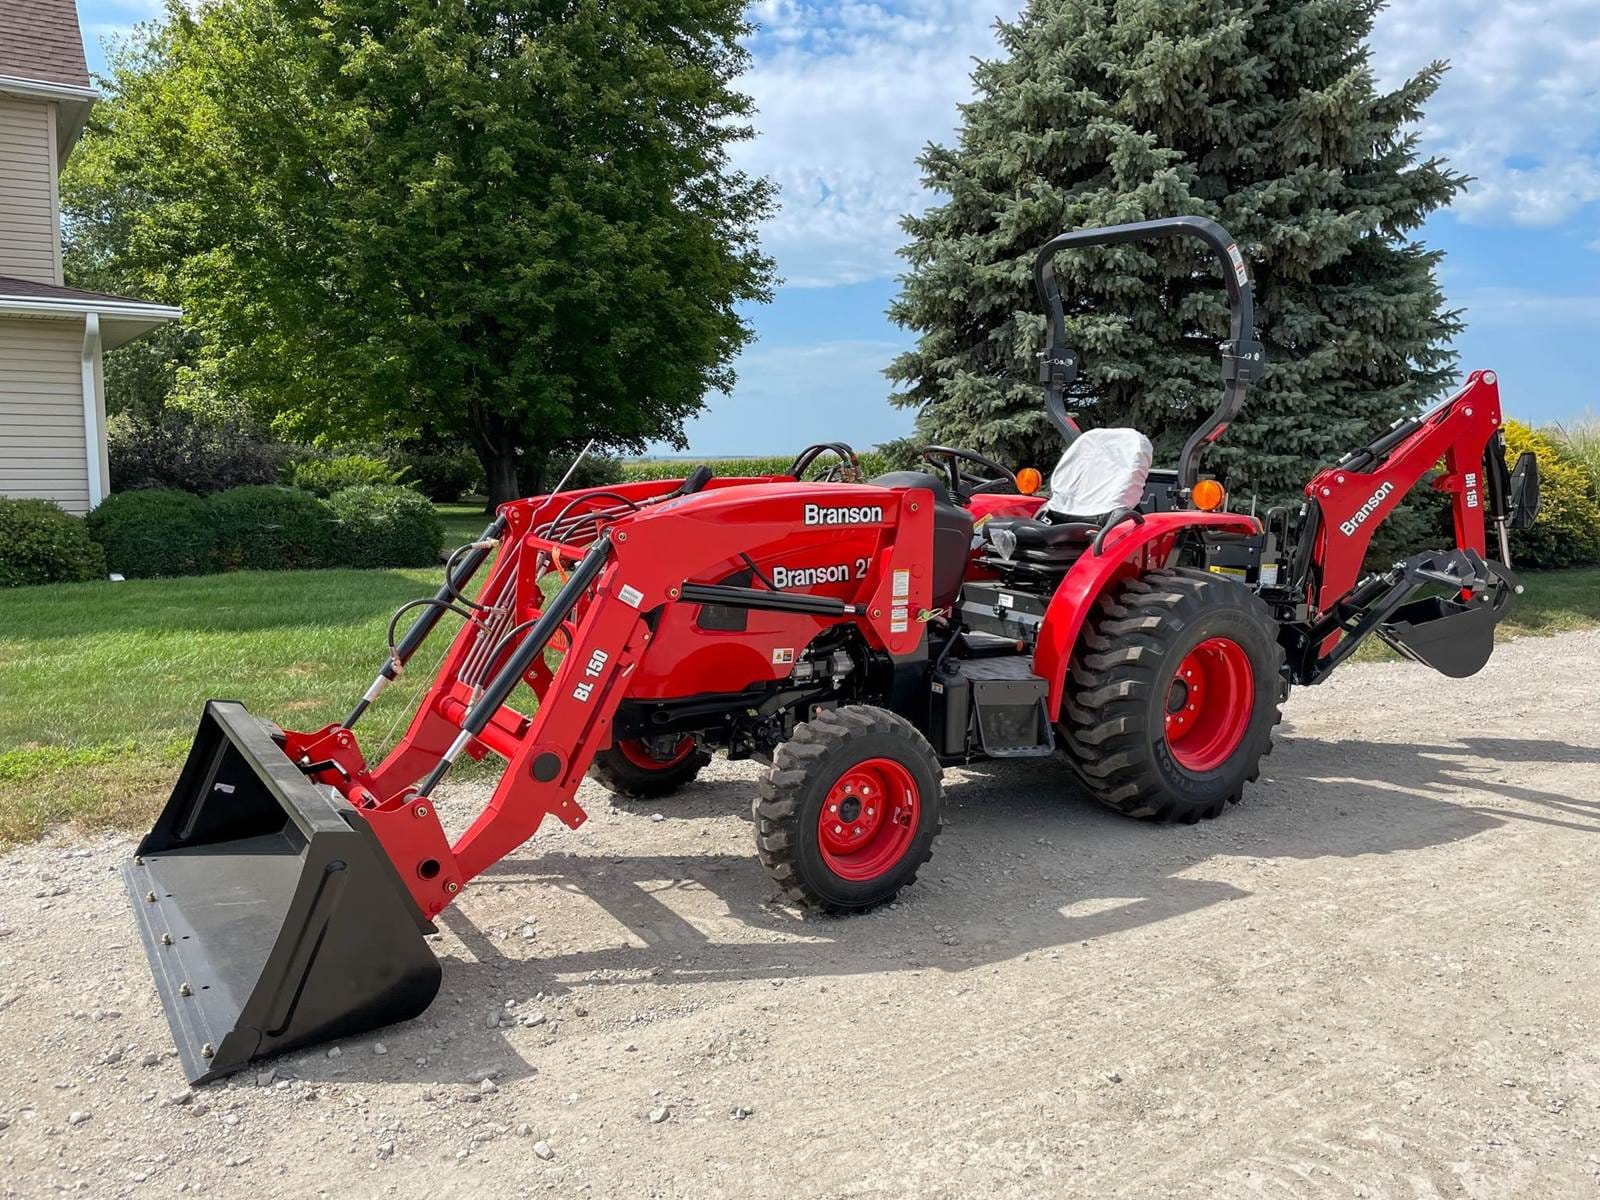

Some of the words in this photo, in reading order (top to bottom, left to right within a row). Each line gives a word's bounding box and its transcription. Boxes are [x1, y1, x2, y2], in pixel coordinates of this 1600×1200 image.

[1465, 473, 1476, 488] BH
[1339, 481, 1394, 537] Branson
[1466, 489, 1478, 508] 150
[804, 503, 883, 525] Branson
[772, 564, 849, 588] Branson
[572, 682, 594, 702] BL
[585, 649, 608, 677] 150
